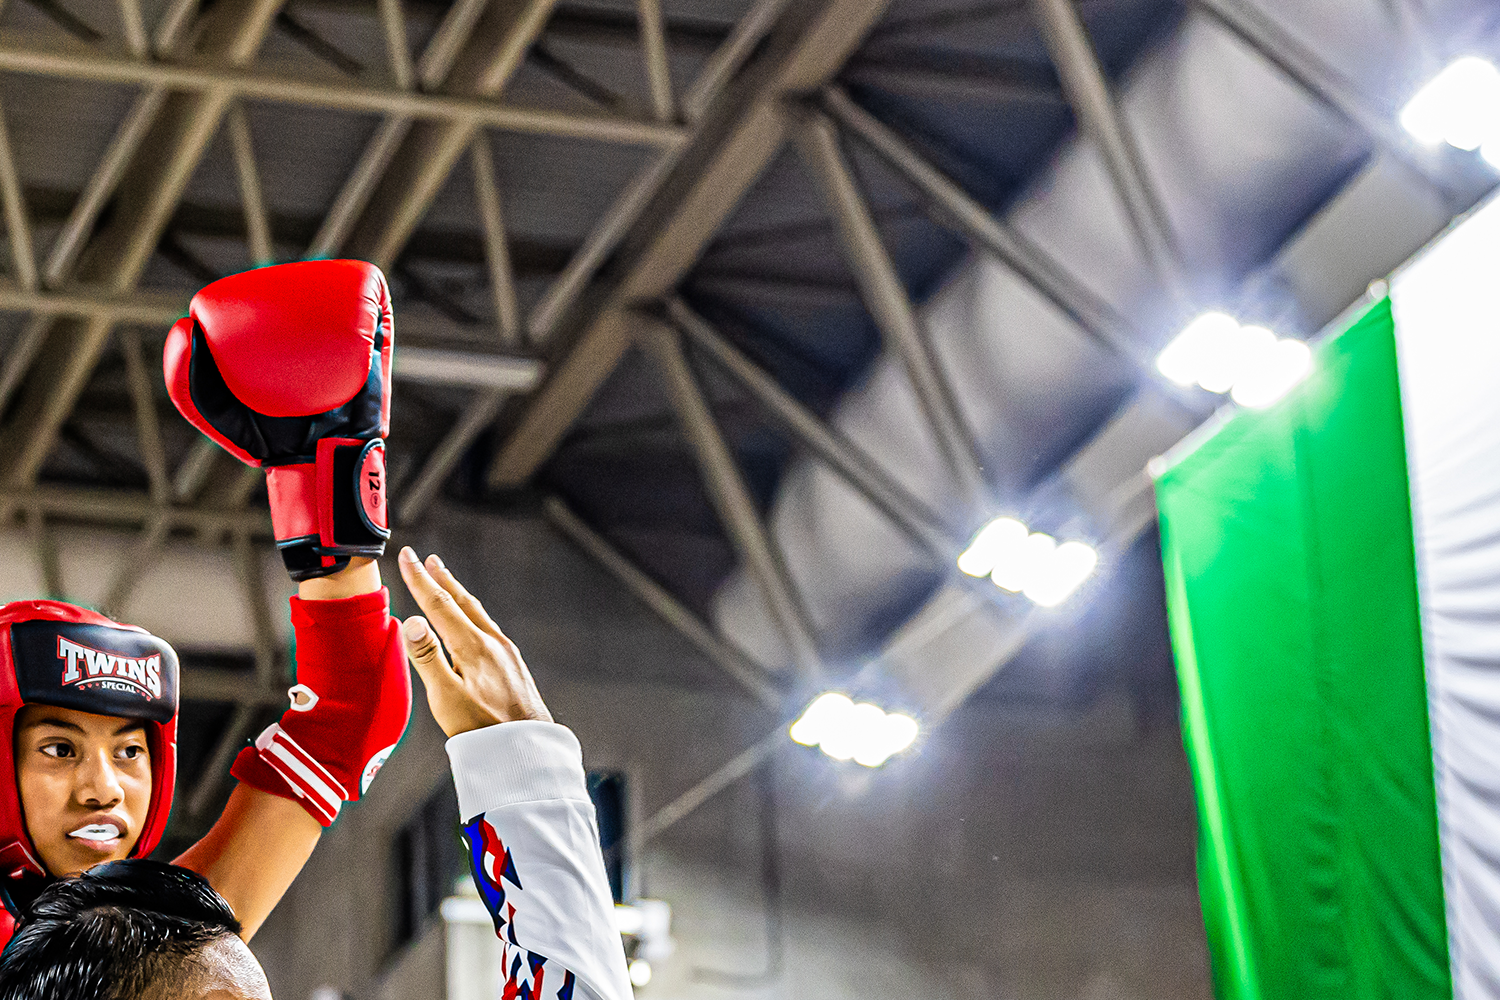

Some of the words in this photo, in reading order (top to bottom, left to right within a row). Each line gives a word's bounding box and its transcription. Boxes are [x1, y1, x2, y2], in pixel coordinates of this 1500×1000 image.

[368, 472, 380, 490] 12
[58, 636, 161, 698] TWINS
[101, 681, 136, 694] SPECIAL
